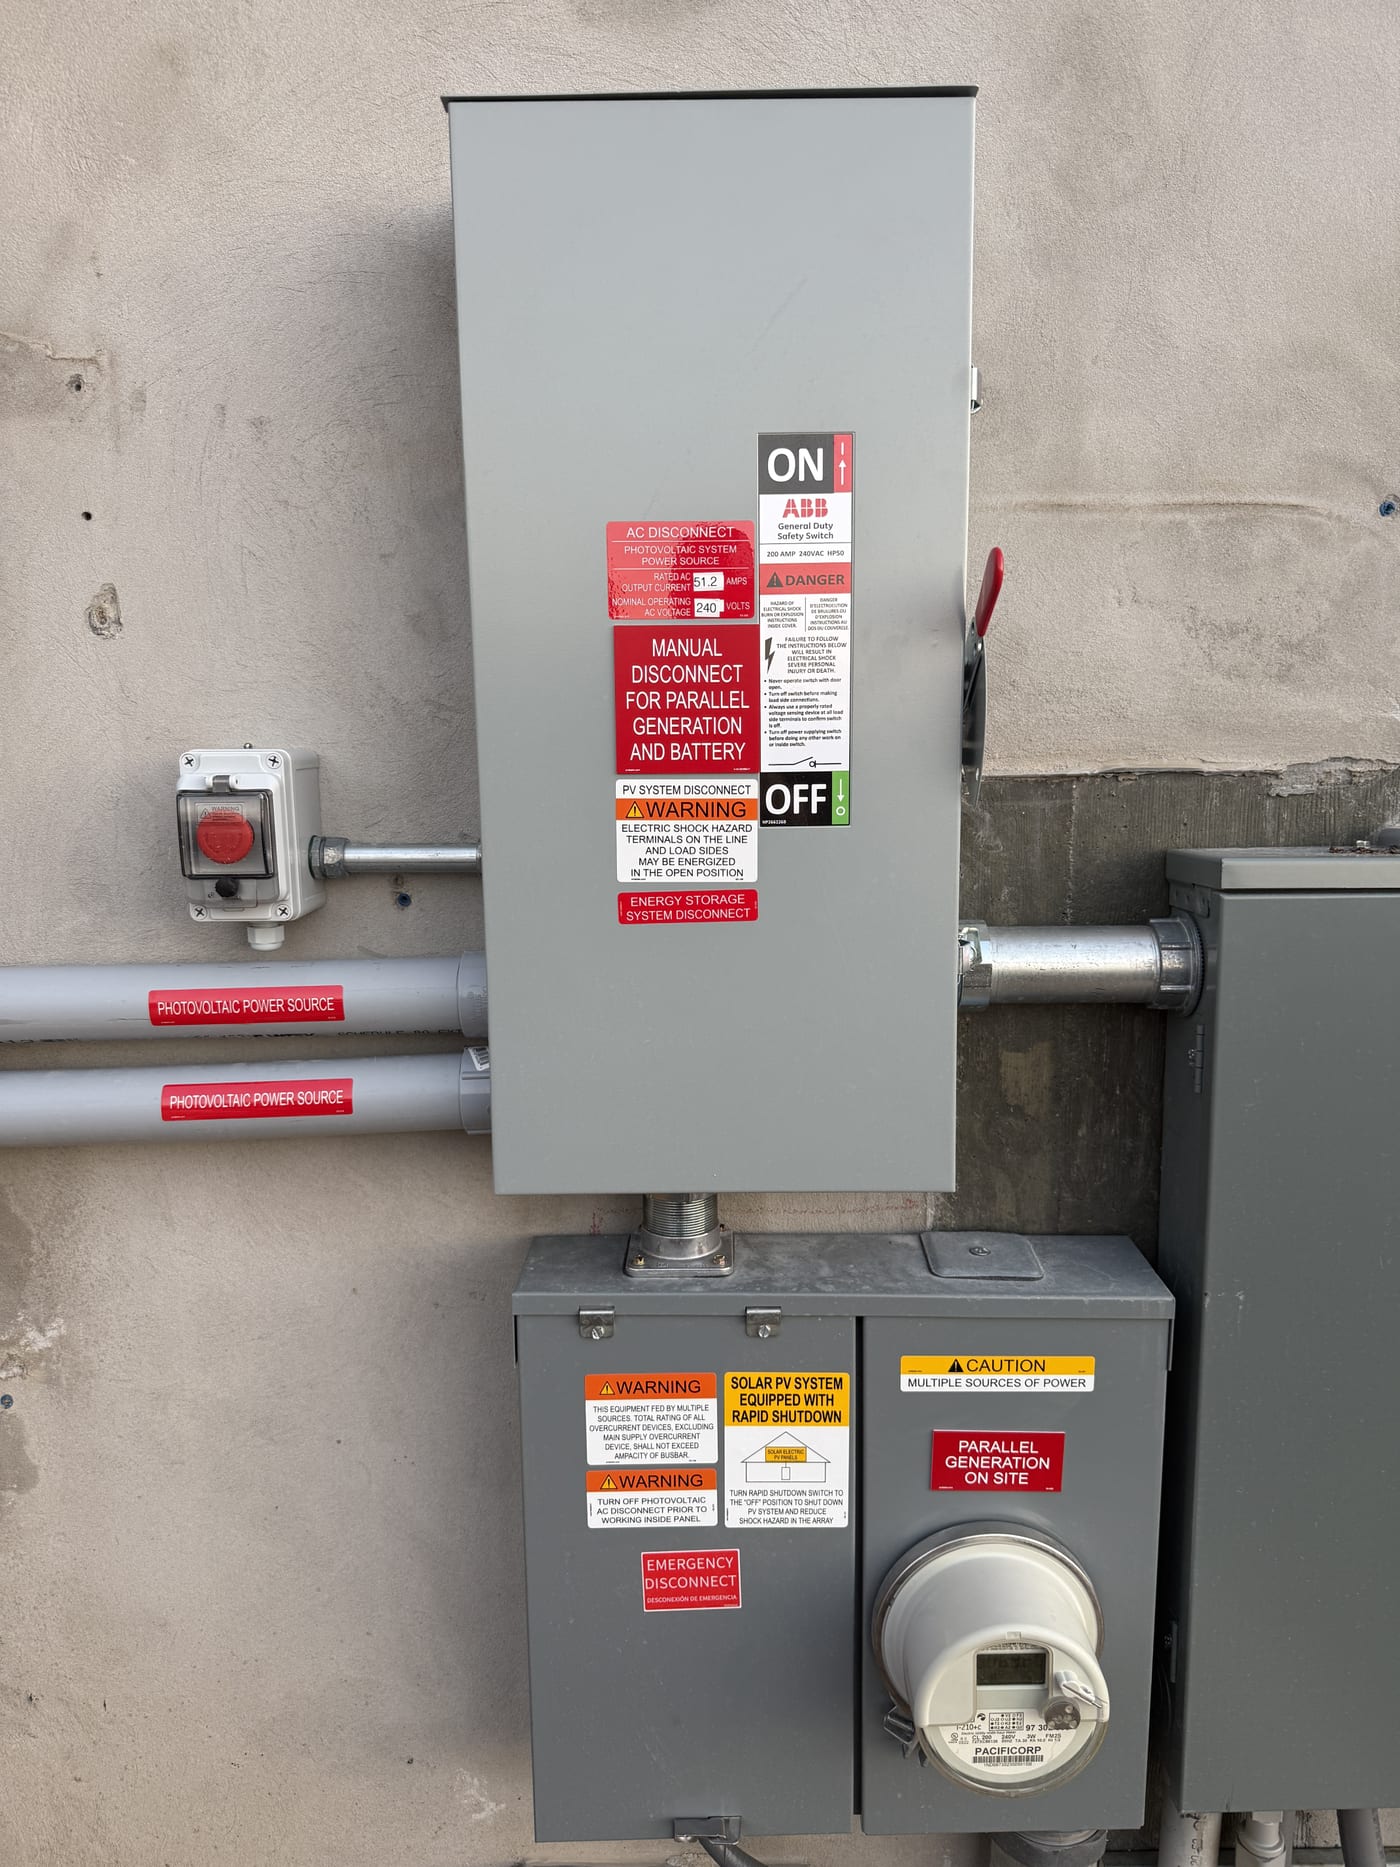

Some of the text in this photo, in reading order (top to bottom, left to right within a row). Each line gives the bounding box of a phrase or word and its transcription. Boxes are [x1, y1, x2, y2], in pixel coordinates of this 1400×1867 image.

[768, 448, 823, 482] ON
[783, 499, 828, 518] ABB
[627, 525, 735, 538] AC DISCONNECT
[778, 523, 833, 533] General Duty
[778, 532, 804, 541] Safety
[625, 544, 696, 554] PHOTOVOLTAIC
[642, 557, 719, 565] POWER SOURCE
[654, 573, 679, 581] RATED
[693, 576, 717, 588] 51.2
[726, 577, 747, 585] AMPS
[785, 574, 845, 586] DANGER
[622, 583, 690, 592] OUTPUT CURRENT
[657, 608, 690, 616] VOLTAGE
[694, 603, 716, 614] 240
[726, 602, 750, 610] VOLTS
[653, 639, 722, 657] MANUAL
[632, 665, 742, 683] DISCONNECT
[627, 691, 749, 709] FOR PARALLEL
[634, 717, 741, 735] GENERATION
[631, 743, 745, 760] AND BATTERY
[623, 785, 751, 795] PV SYSTEM DISCONNECT
[766, 784, 826, 814] OFF
[646, 801, 746, 818] WARNING
[622, 824, 752, 832] ELECTRIC SHOCK HAZARD
[626, 835, 683, 844] TERMINALS
[686, 835, 700, 843] ON
[726, 836, 747, 844] LINE
[699, 847, 728, 855] SIDES
[678, 858, 735, 866] ENERGIZED
[666, 869, 693, 877] OPEN
[697, 869, 743, 877] POSITION
[631, 894, 744, 907] ENERGY STORAGE
[627, 908, 750, 921] SYSTEM DISCONNECT
[158, 998, 334, 1015] PHOTOVOLTAIC POWER SOURCE
[170, 1090, 344, 1109] PHOTOVOLTAIC POWER SOURCE
[967, 1359, 1045, 1372] CAUTION
[617, 1380, 700, 1394] WARNING
[731, 1377, 842, 1390] SOLAR PV SYSTEM
[908, 1379, 1086, 1387] MULTIPLE SOURCES OF POWER
[740, 1394, 834, 1406] EQUIPPED WITH
[733, 1410, 841, 1423] RAPID SHUTDOWN
[959, 1441, 1038, 1453] PARALLEL
[946, 1456, 1049, 1469] GENERATION
[619, 1474, 703, 1488] WARNING
[965, 1472, 1028, 1484] ON SITE
[648, 1557, 733, 1571] EMERGENCY
[645, 1575, 736, 1590] DISCONNECT
[975, 1746, 1041, 1755] PACIFICORP
